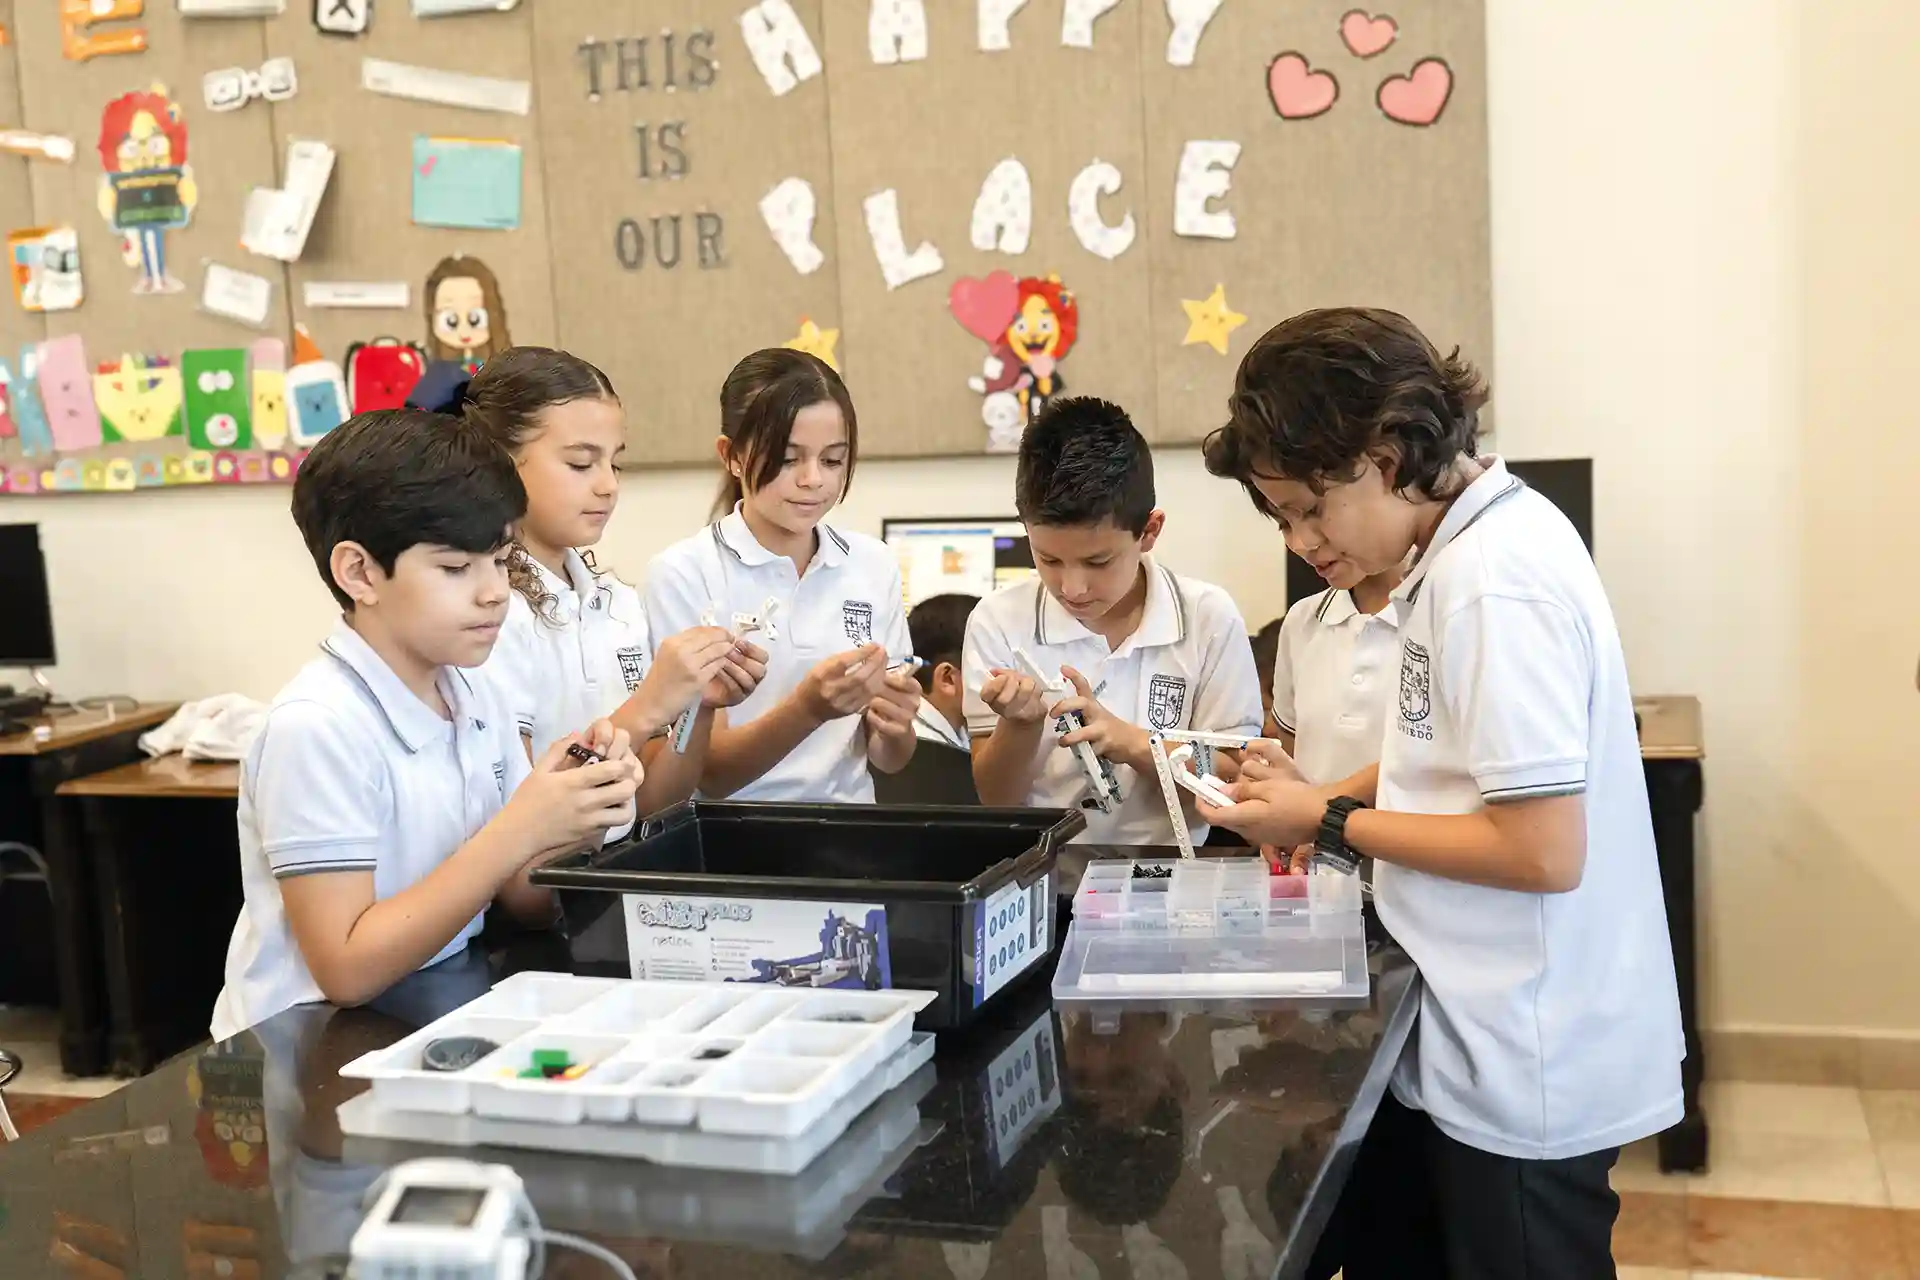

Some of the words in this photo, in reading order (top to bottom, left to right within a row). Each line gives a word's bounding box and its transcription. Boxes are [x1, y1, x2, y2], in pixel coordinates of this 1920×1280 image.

[578, 31, 717, 95] THIS
[634, 122, 691, 178] IS
[615, 212, 730, 271] OUR
[758, 139, 1242, 291] PLACE
